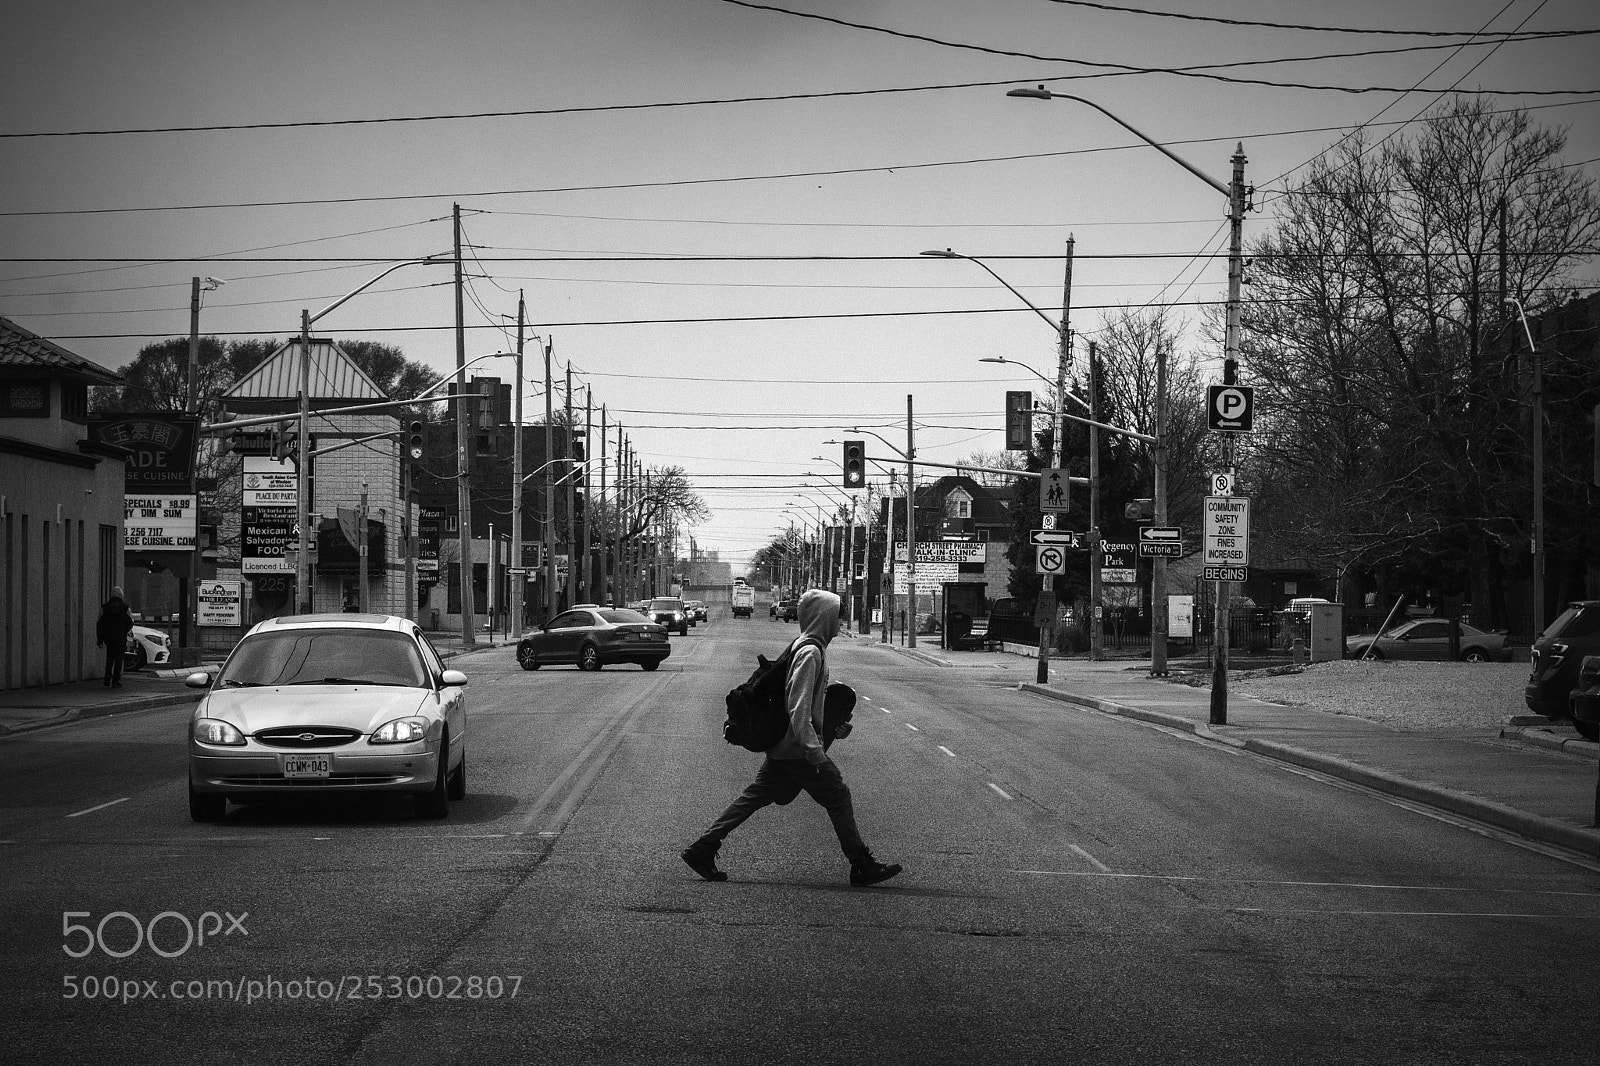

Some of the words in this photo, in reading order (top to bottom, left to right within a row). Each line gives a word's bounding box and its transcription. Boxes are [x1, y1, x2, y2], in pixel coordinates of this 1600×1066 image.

[143, 472, 184, 481] CUISINE
[255, 492, 271, 500] PLACE
[272, 492, 279, 500] DU
[124, 499, 162, 508] SPECIALS
[169, 499, 190, 509] $8.99
[1208, 502, 1246, 512] COMMUNITY
[141, 508, 157, 518] DIM
[163, 509, 182, 518] SUM
[1215, 514, 1239, 523] SAFETY
[131, 527, 146, 536] 256
[148, 527, 164, 537] 7117
[247, 526, 287, 535] Mexican
[1218, 525, 1236, 535] ZONE
[896, 542, 931, 550] CHRCH
[931, 542, 954, 550] STREET
[954, 542, 984, 550] PHARMACY
[1100, 539, 1136, 553] Regency
[1217, 538, 1236, 548] FINES
[257, 546, 287, 555] FOOD
[1142, 544, 1171, 554] Victoria
[1208, 549, 1244, 559] INCREASED
[1104, 554, 1125, 567] Park
[244, 562, 277, 570] Licenced
[1205, 568, 1245, 580] BEGINS
[259, 577, 286, 592] 225
[201, 588, 237, 596] Buckingham
[286, 761, 307, 772] CCWM
[311, 760, 328, 772] 043
